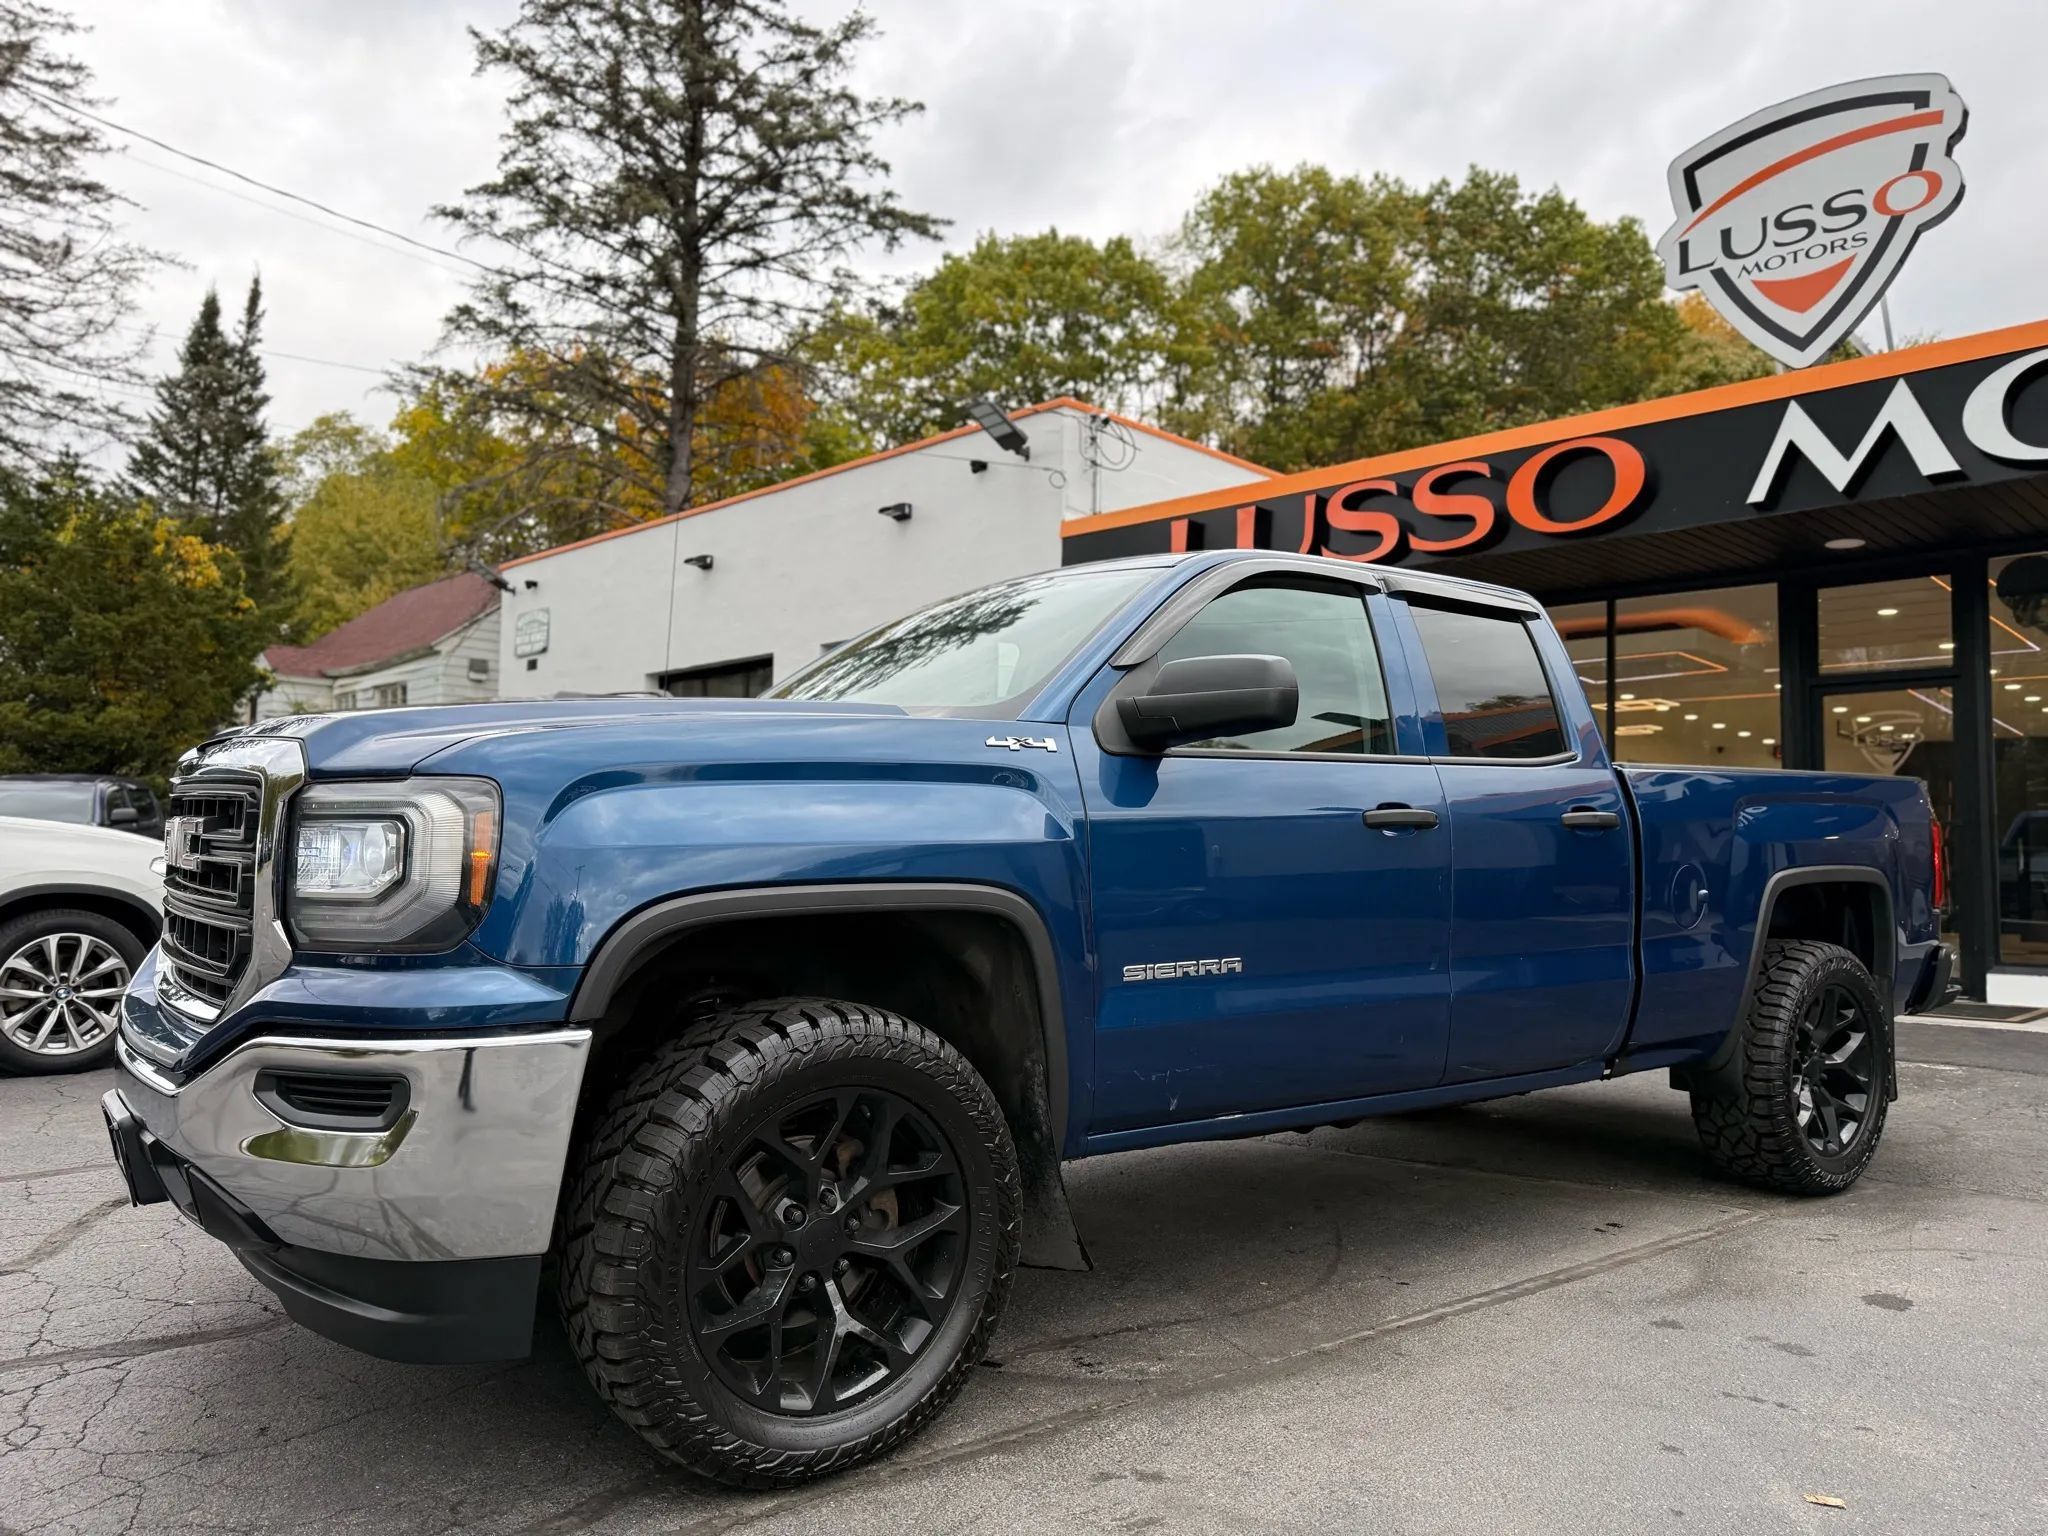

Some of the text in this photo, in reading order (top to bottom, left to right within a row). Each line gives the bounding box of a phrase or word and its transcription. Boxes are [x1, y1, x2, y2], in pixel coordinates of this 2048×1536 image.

[1678, 170, 1943, 276] LUSSO
[1737, 232, 1868, 279] MOTORS
[1123, 957, 1242, 982] SIERRA
